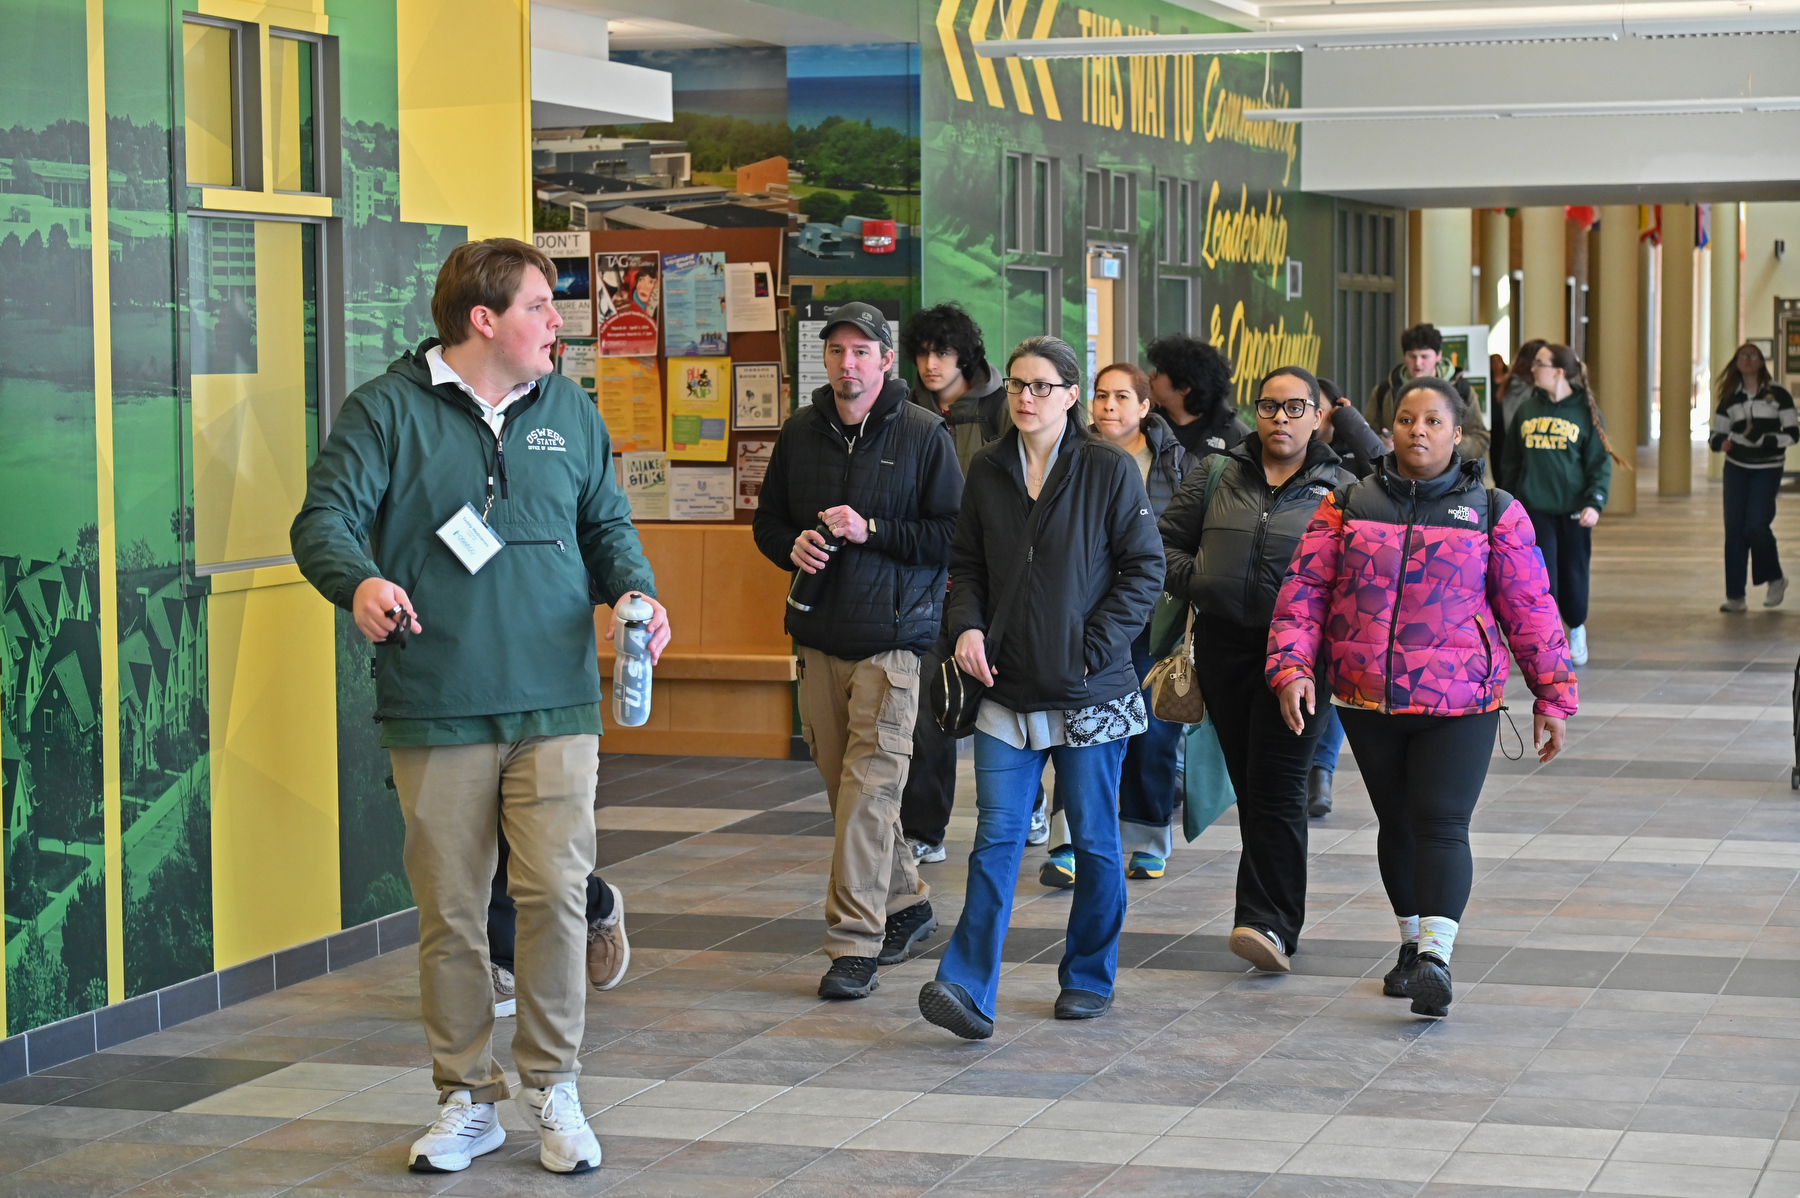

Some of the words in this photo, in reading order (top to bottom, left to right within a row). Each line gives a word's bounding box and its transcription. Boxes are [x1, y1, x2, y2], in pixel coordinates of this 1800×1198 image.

[1078, 9, 1124, 131] THIS
[1128, 24, 1166, 139] WAY
[1174, 53, 1194, 145] TO
[536, 234, 581, 249] DON'T
[1202, 180, 1288, 289] Leadership
[605, 255, 628, 268] TAG
[805, 304, 811, 318] 1
[1228, 300, 1321, 405] Opportunity
[526, 428, 565, 446] OSWEGO
[1521, 417, 1580, 443] OSWEGO
[537, 438, 557, 446] STATE
[1525, 435, 1567, 449] STATE
